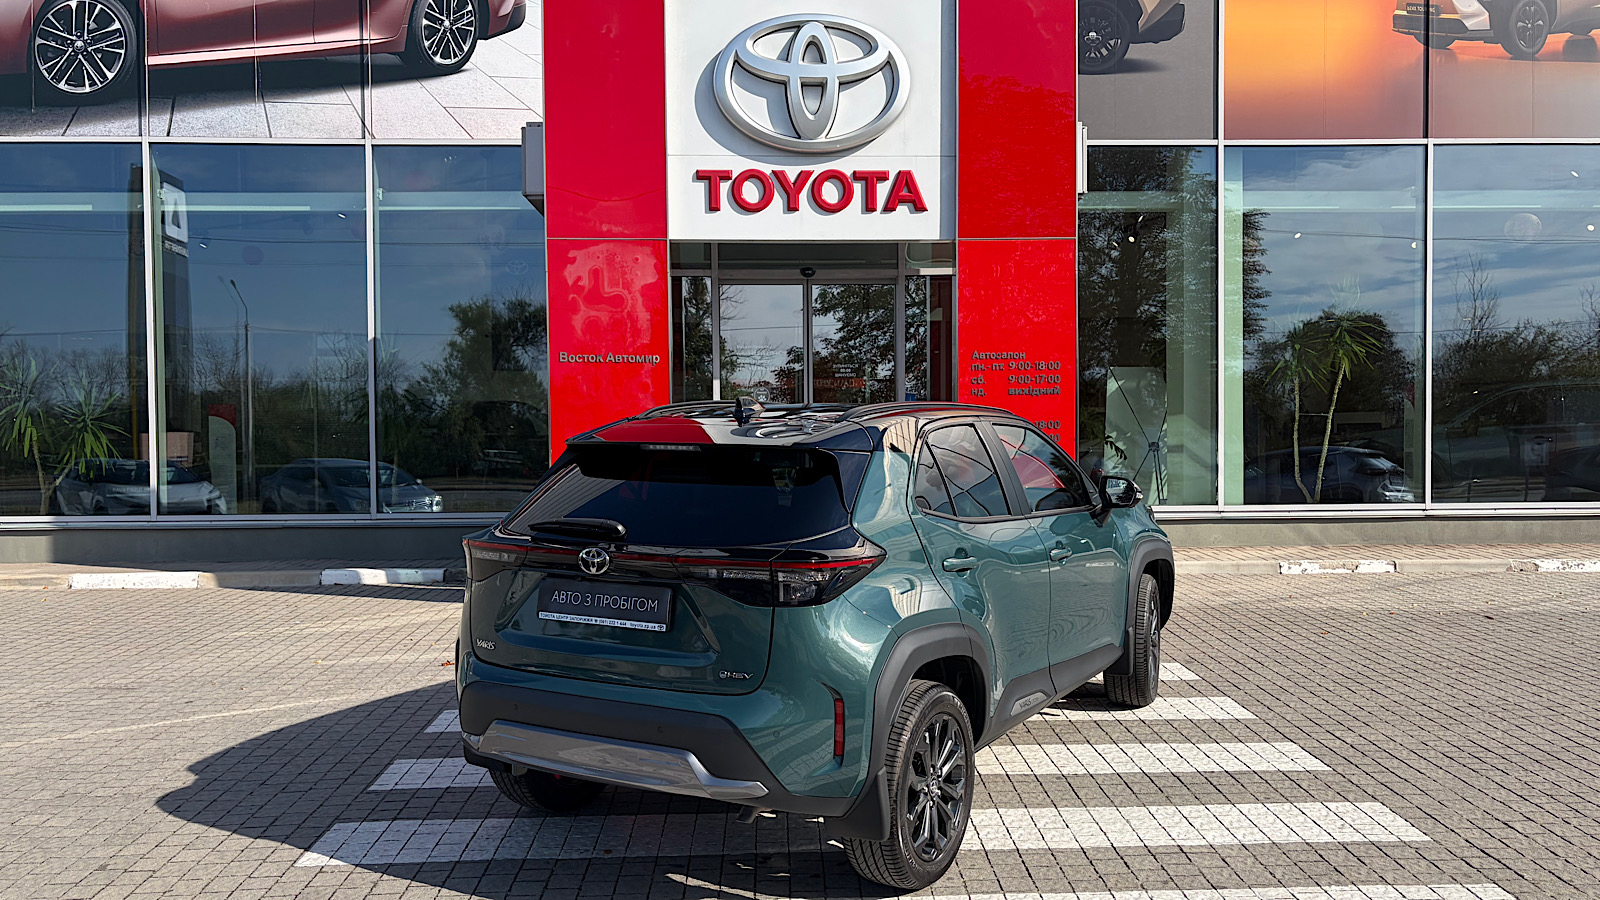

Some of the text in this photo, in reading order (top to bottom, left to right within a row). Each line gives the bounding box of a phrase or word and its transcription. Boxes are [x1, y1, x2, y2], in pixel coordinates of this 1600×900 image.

[695, 168, 929, 214] TOYOTA
[559, 351, 660, 366] Восток Автомир
[971, 350, 1026, 360] Автосалон
[1008, 361, 1061, 371] 9:00-18:00
[1008, 374, 1061, 384] 9:00-17:00
[1008, 385, 1061, 396] вихідний
[551, 590, 582, 605] АВТО
[594, 594, 658, 613] ПРОБІГОМ
[476, 638, 496, 650] YARIS
